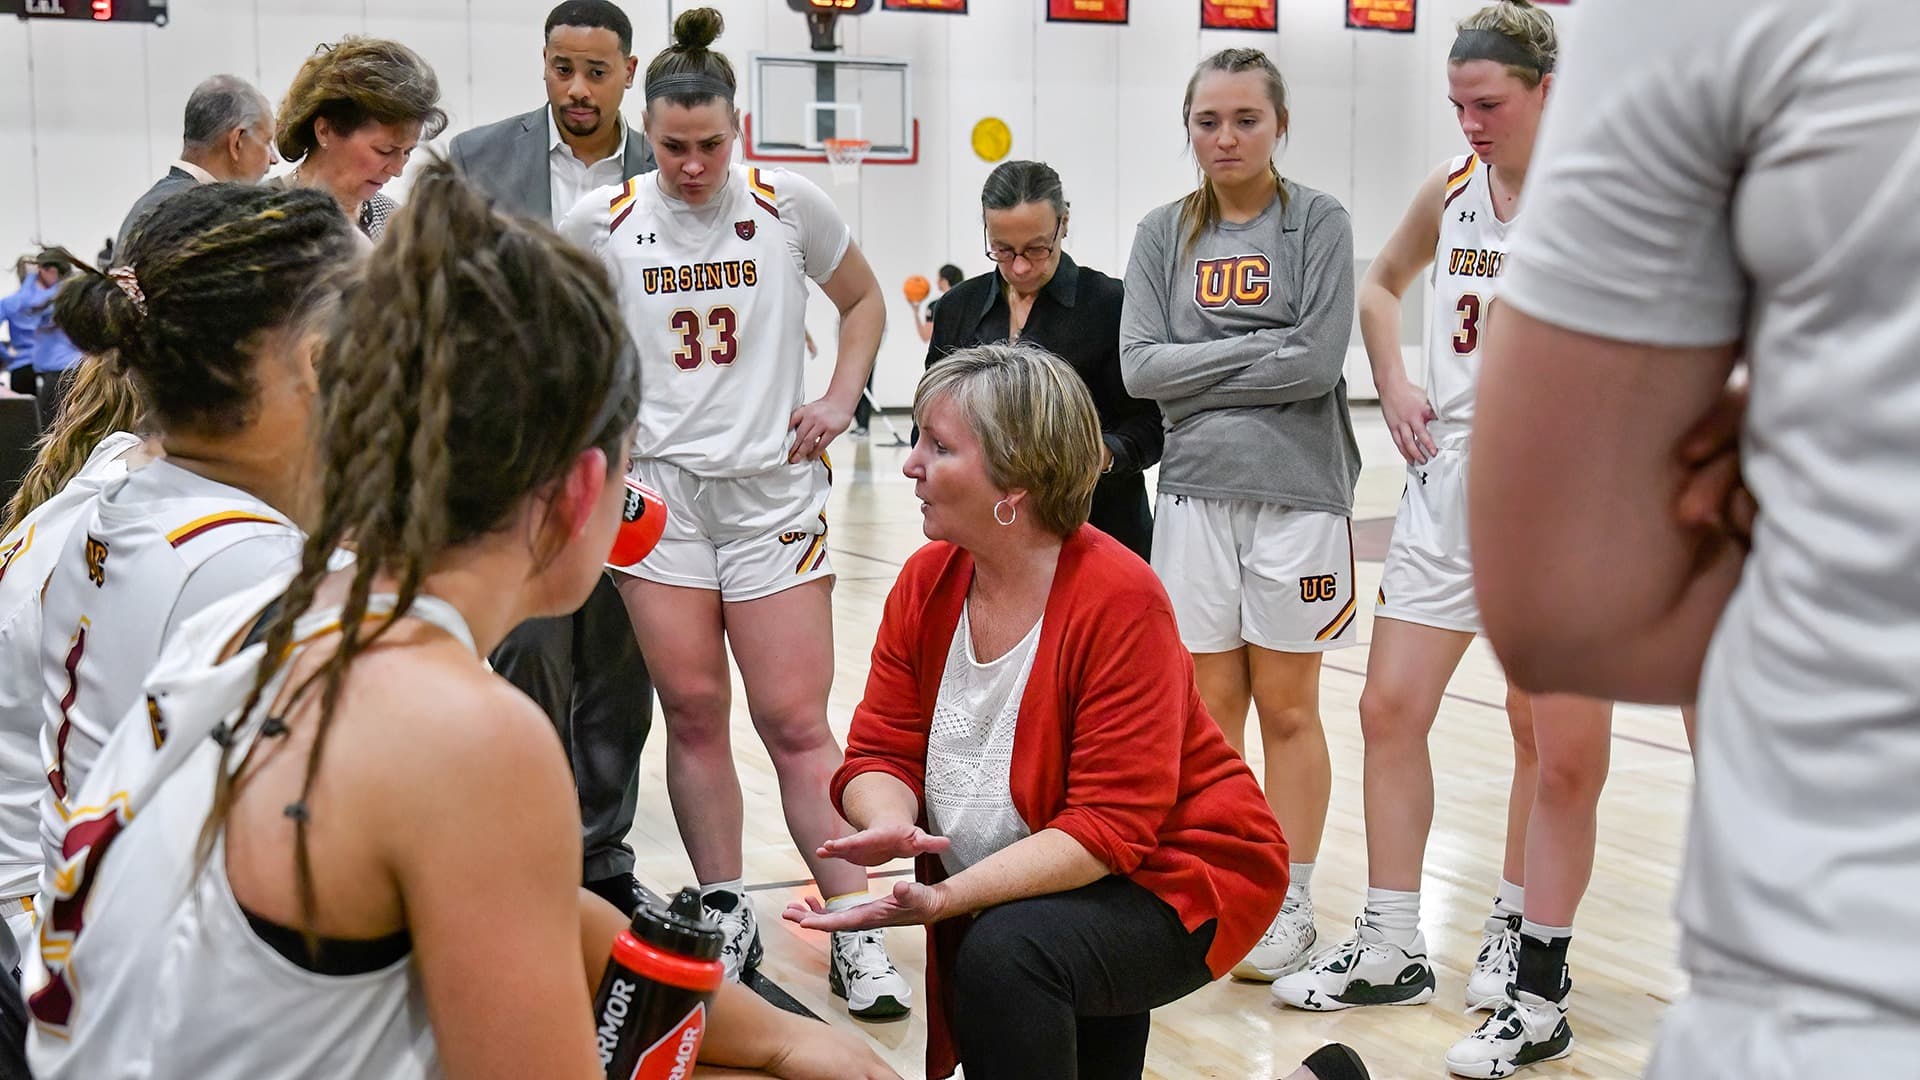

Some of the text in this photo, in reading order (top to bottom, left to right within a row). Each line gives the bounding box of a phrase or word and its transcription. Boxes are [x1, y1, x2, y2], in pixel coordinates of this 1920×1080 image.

[643, 260, 758, 295] URSINUS
[1194, 253, 1271, 310] UC
[1449, 247, 1506, 278] URSI
[668, 304, 739, 372] 33
[1451, 292, 1492, 357] 3
[1300, 574, 1336, 602] UC
[598, 978, 636, 1070] ARMOR
